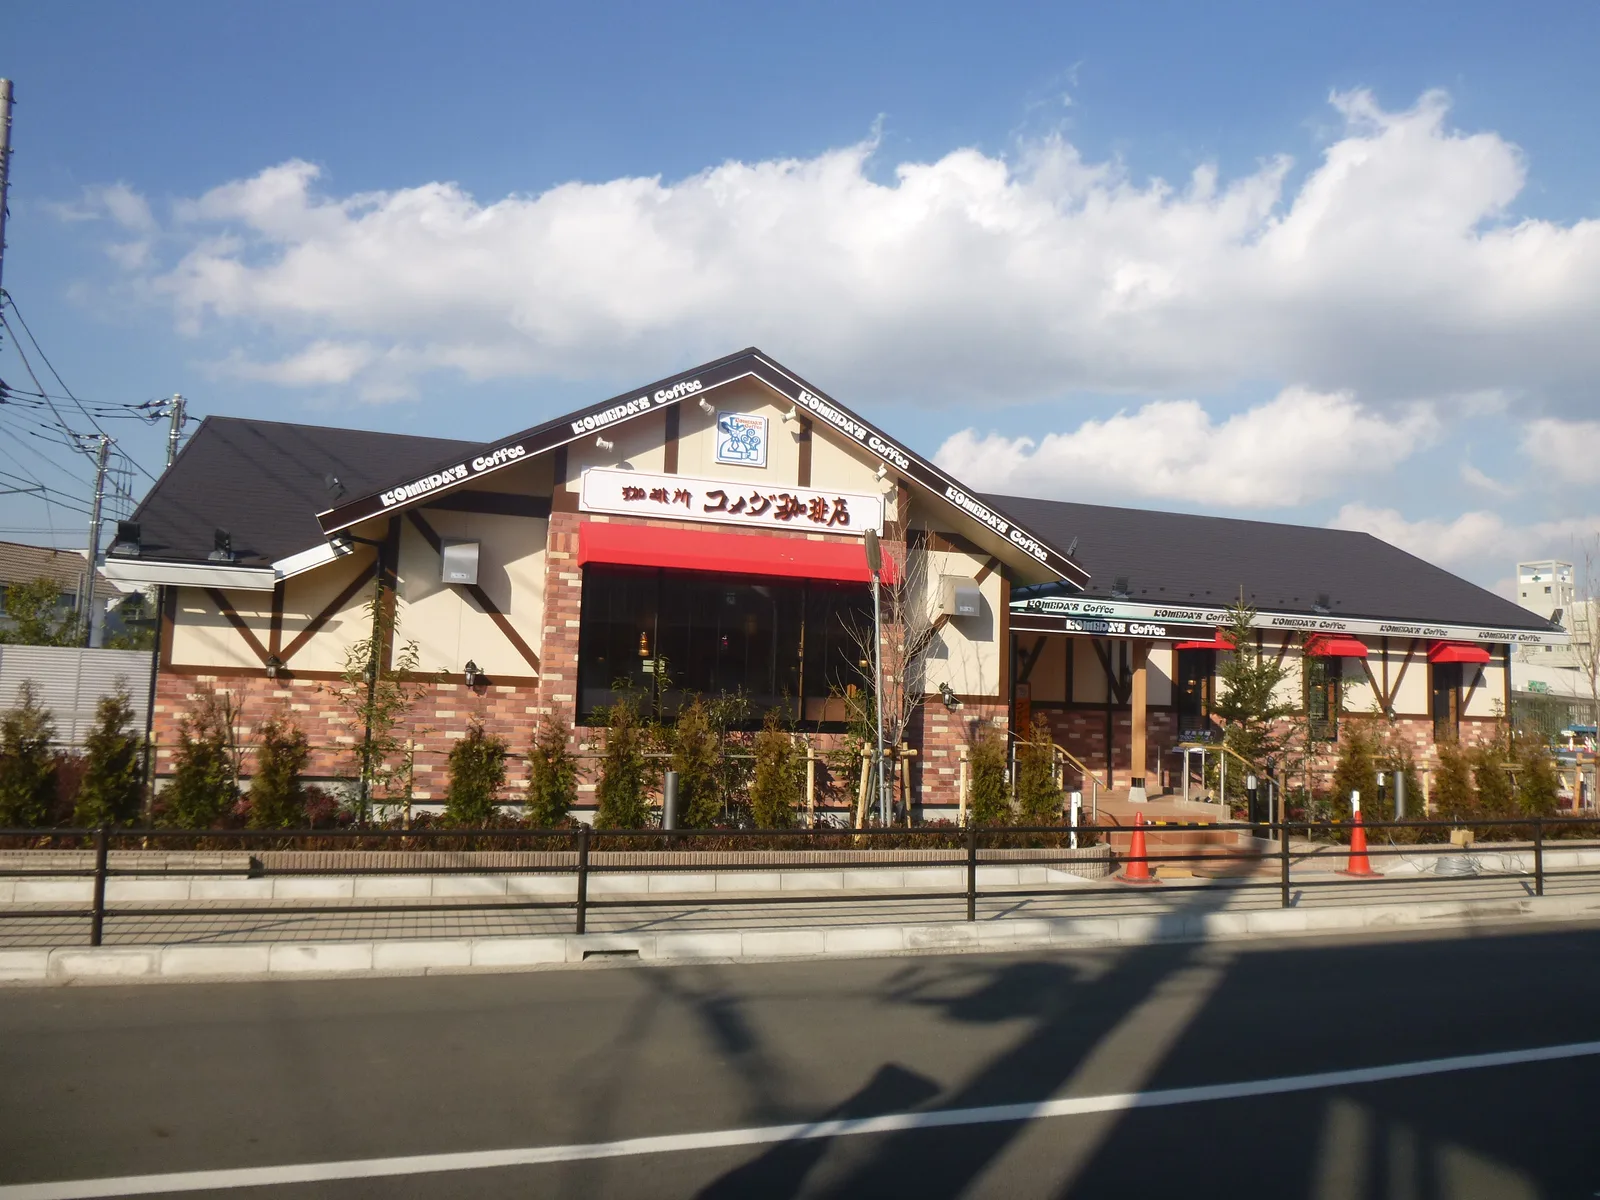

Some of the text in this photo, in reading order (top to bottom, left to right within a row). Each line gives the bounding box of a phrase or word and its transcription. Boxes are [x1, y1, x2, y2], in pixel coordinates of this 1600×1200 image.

[571, 380, 703, 435] KOMEDA'S Coffee
[798, 390, 910, 470] KOMEDA'S Coffee
[380, 445, 526, 507] KOMEDA'S Coffee
[622, 486, 850, 527] 珈琲所 コメダ珈琲店
[945, 486, 1048, 561] KOMEDA'S Coffee
[1026, 600, 1114, 614] KOMEDA'S Coffee
[1154, 610, 1203, 620] KOMEDA'S
[1066, 619, 1166, 636] KOMEDA'S Coffee
[1272, 618, 1346, 630] KOMEDA'S Coffee
[1380, 625, 1421, 634] KOMEDA'S
